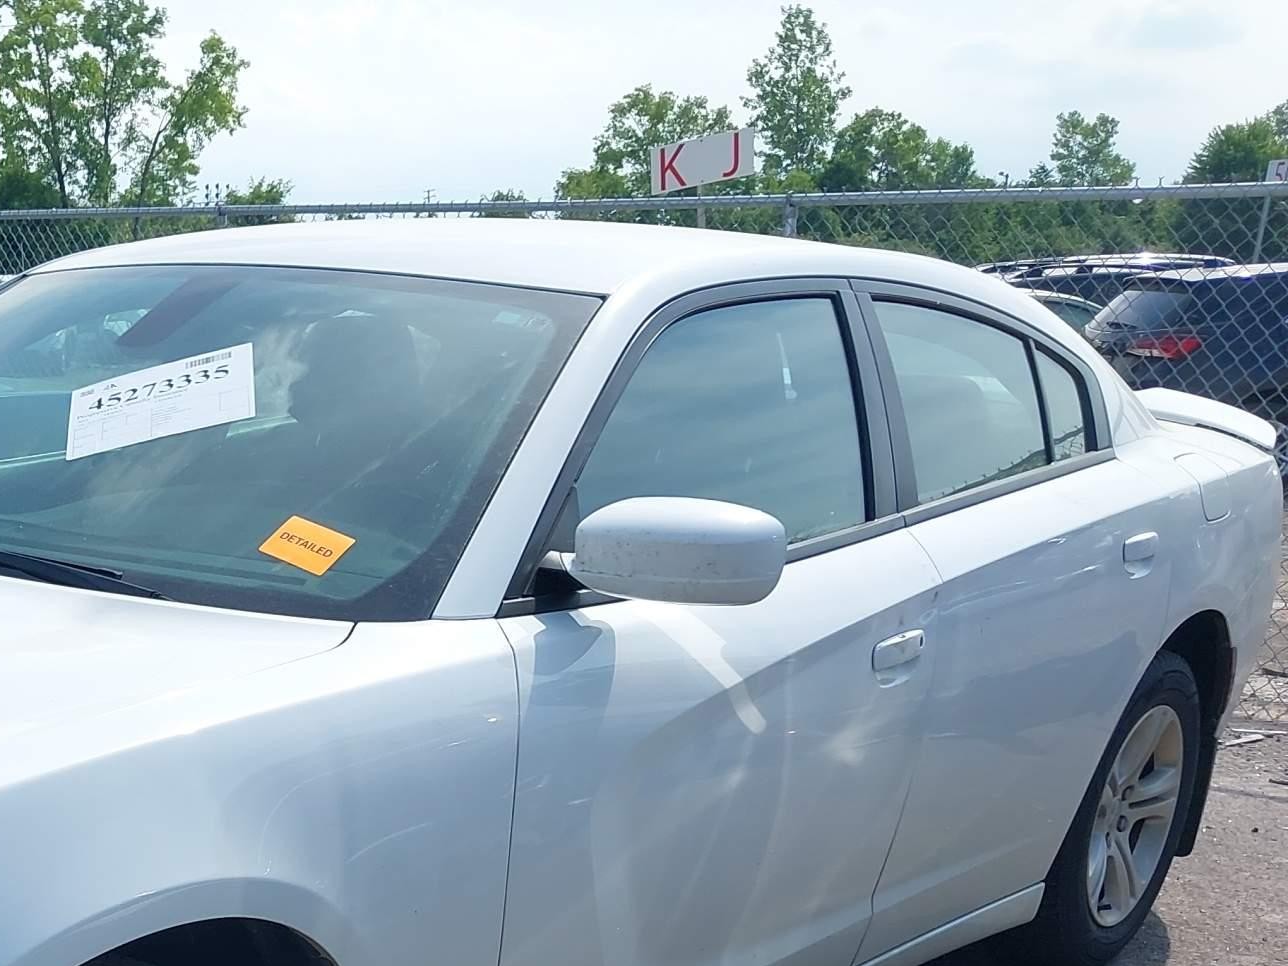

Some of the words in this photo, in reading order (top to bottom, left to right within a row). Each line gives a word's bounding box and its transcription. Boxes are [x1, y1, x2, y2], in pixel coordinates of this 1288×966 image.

[659, 143, 687, 191] K
[722, 131, 740, 178] J
[88, 364, 230, 410] 45273335
[279, 531, 334, 558] DETAILED
